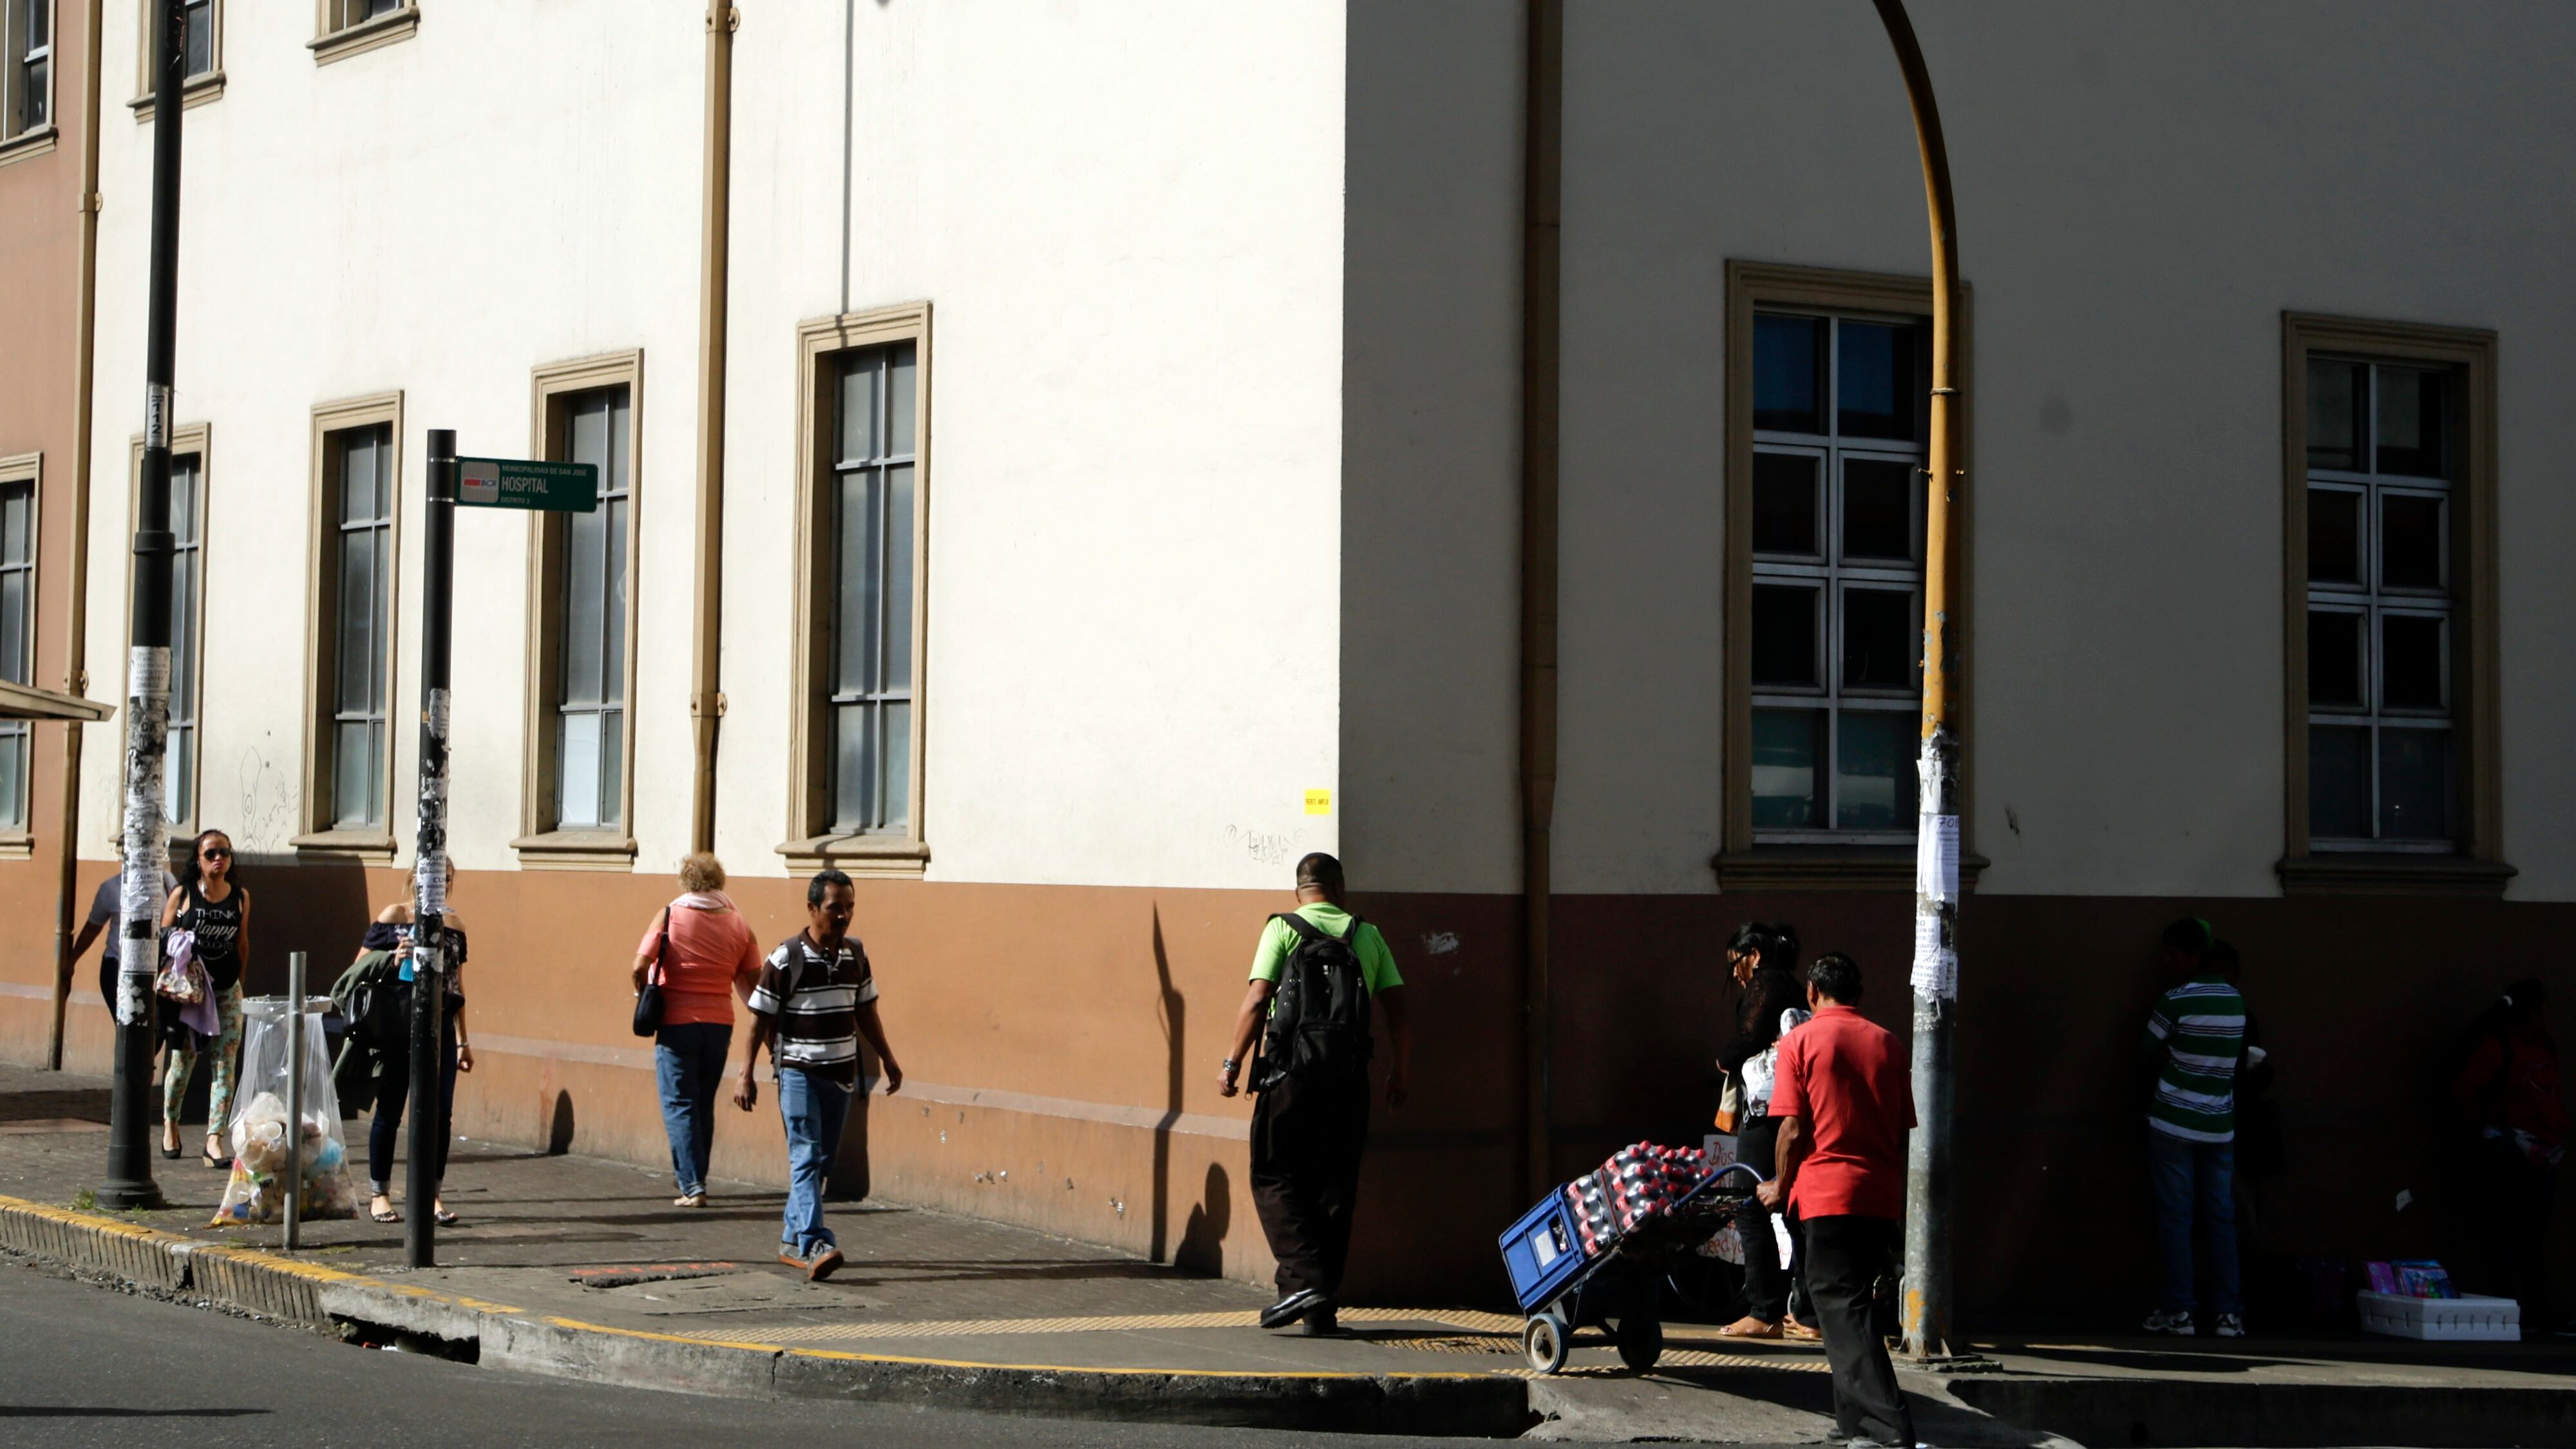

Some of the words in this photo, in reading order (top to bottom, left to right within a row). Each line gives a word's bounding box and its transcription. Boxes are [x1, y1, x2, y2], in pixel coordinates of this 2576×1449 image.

[151, 402, 162, 434] 112
[502, 465, 549, 474] MUNICIPALIDAD
[502, 476, 549, 494] HOSPITAL
[195, 907, 236, 920] THINK
[192, 919, 238, 940] Happy
[1709, 1141, 1735, 1166] Dios
